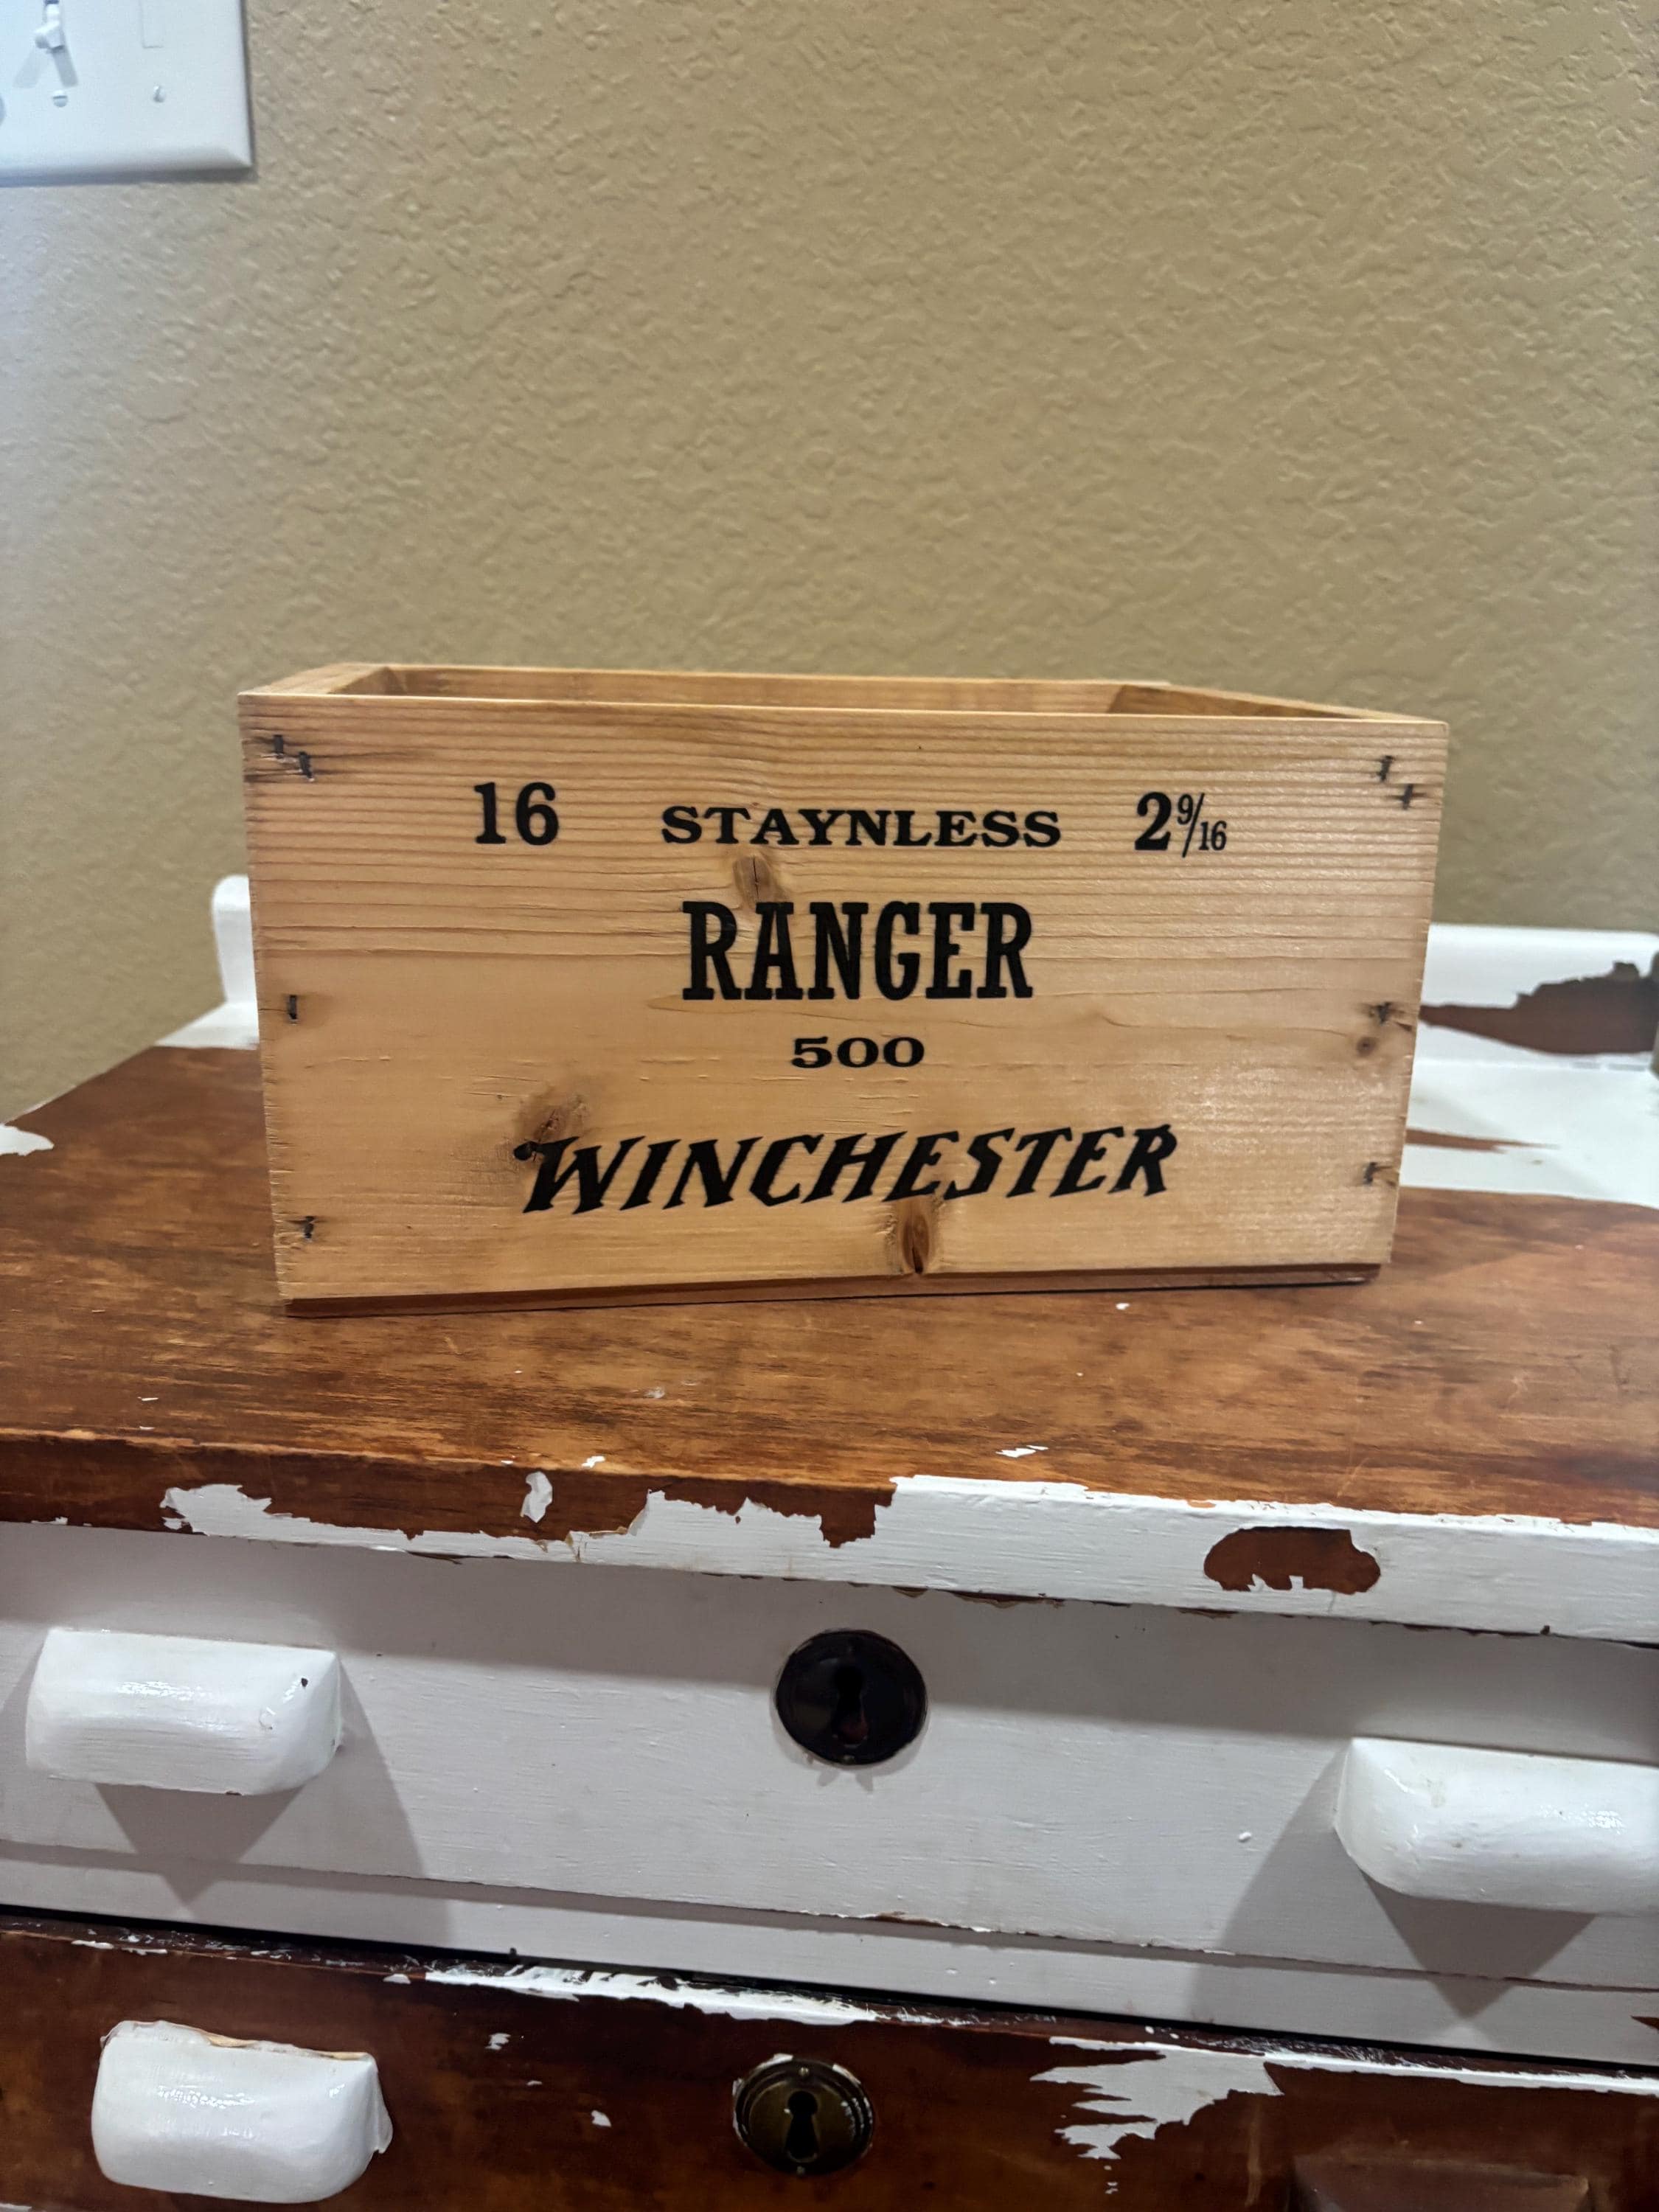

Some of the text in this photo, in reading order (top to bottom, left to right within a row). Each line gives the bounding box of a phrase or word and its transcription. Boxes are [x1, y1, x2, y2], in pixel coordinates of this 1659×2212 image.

[473, 782, 560, 846] 16
[661, 805, 1062, 848] STAYNLESS
[682, 900, 1034, 1001] RANGER
[790, 1036, 925, 1069] 500
[513, 1123, 1178, 1214] WINCHESTER
